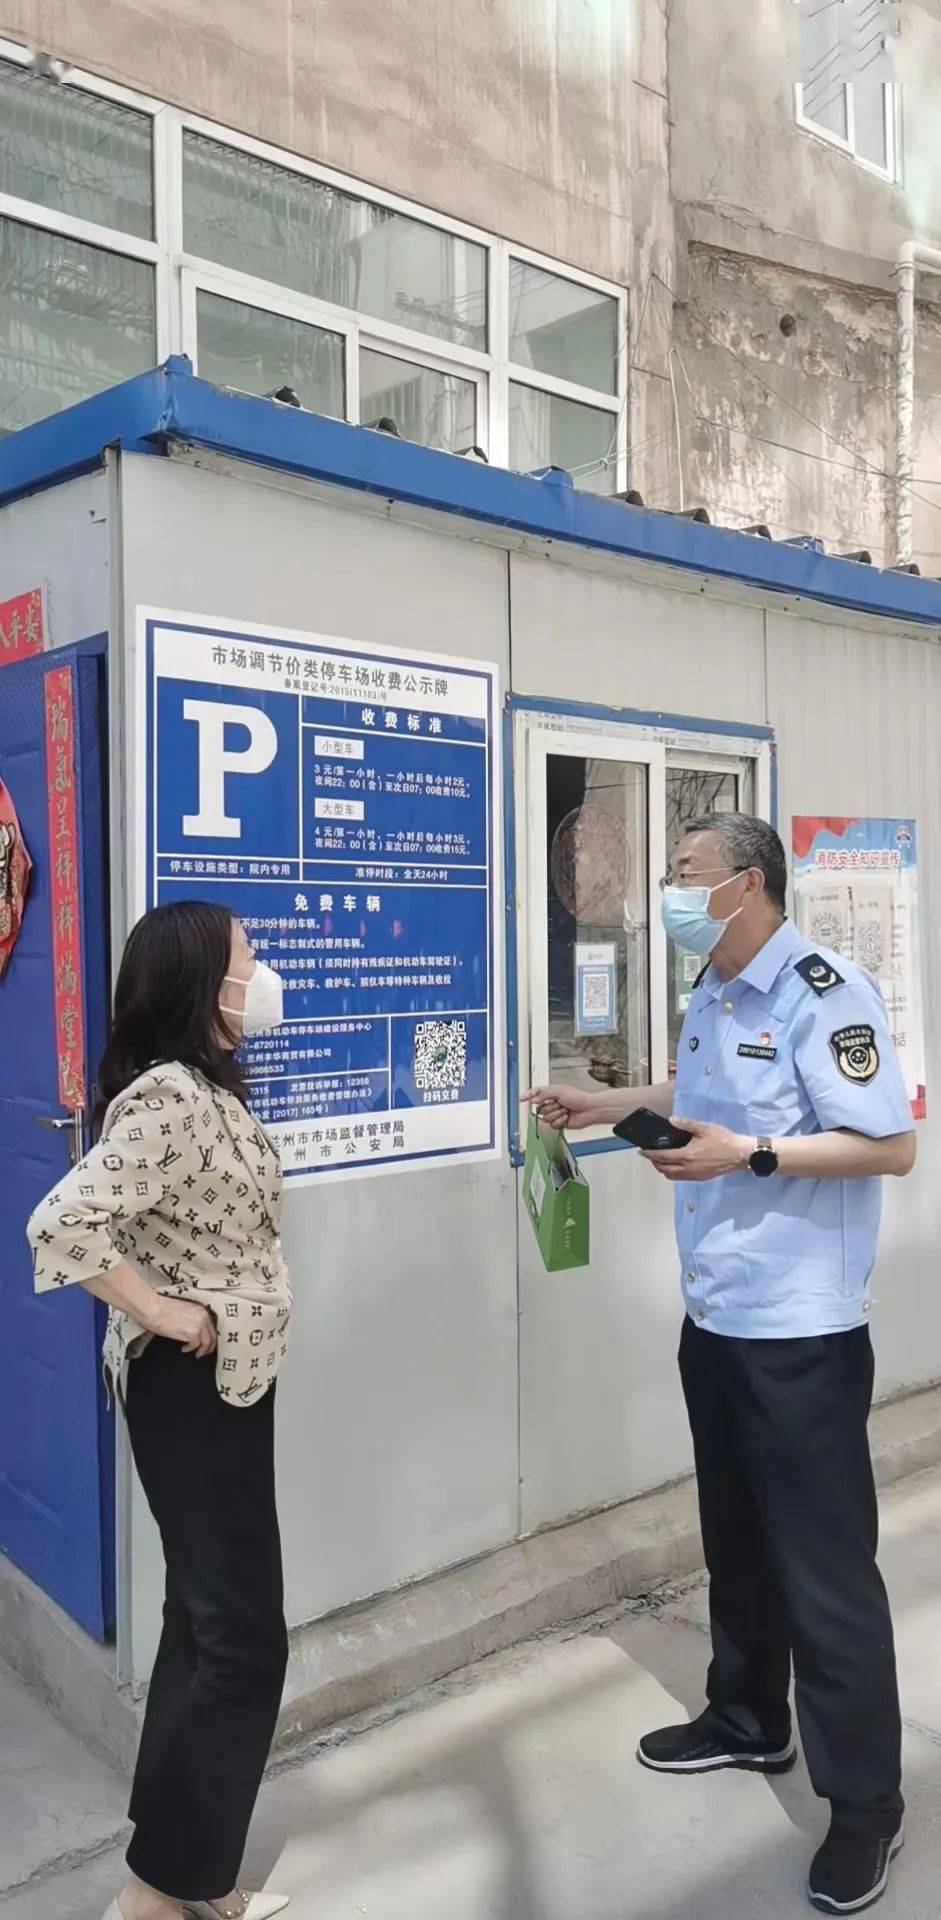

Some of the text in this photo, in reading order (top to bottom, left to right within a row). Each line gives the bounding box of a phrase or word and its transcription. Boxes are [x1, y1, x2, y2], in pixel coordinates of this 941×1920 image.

[212, 645, 448, 697] 市场调节价类停车场收费公示牌
[361, 707, 443, 734] 收费标准
[322, 740, 355, 755] 小型车
[183, 699, 278, 839] P
[322, 803, 355, 816] 大型车
[170, 860, 449, 881] 停车设施类型：院内专用 准停时段：全天24小时
[294, 892, 382, 912] 免费车辆
[423, 1089, 459, 1103] 扫码交费
